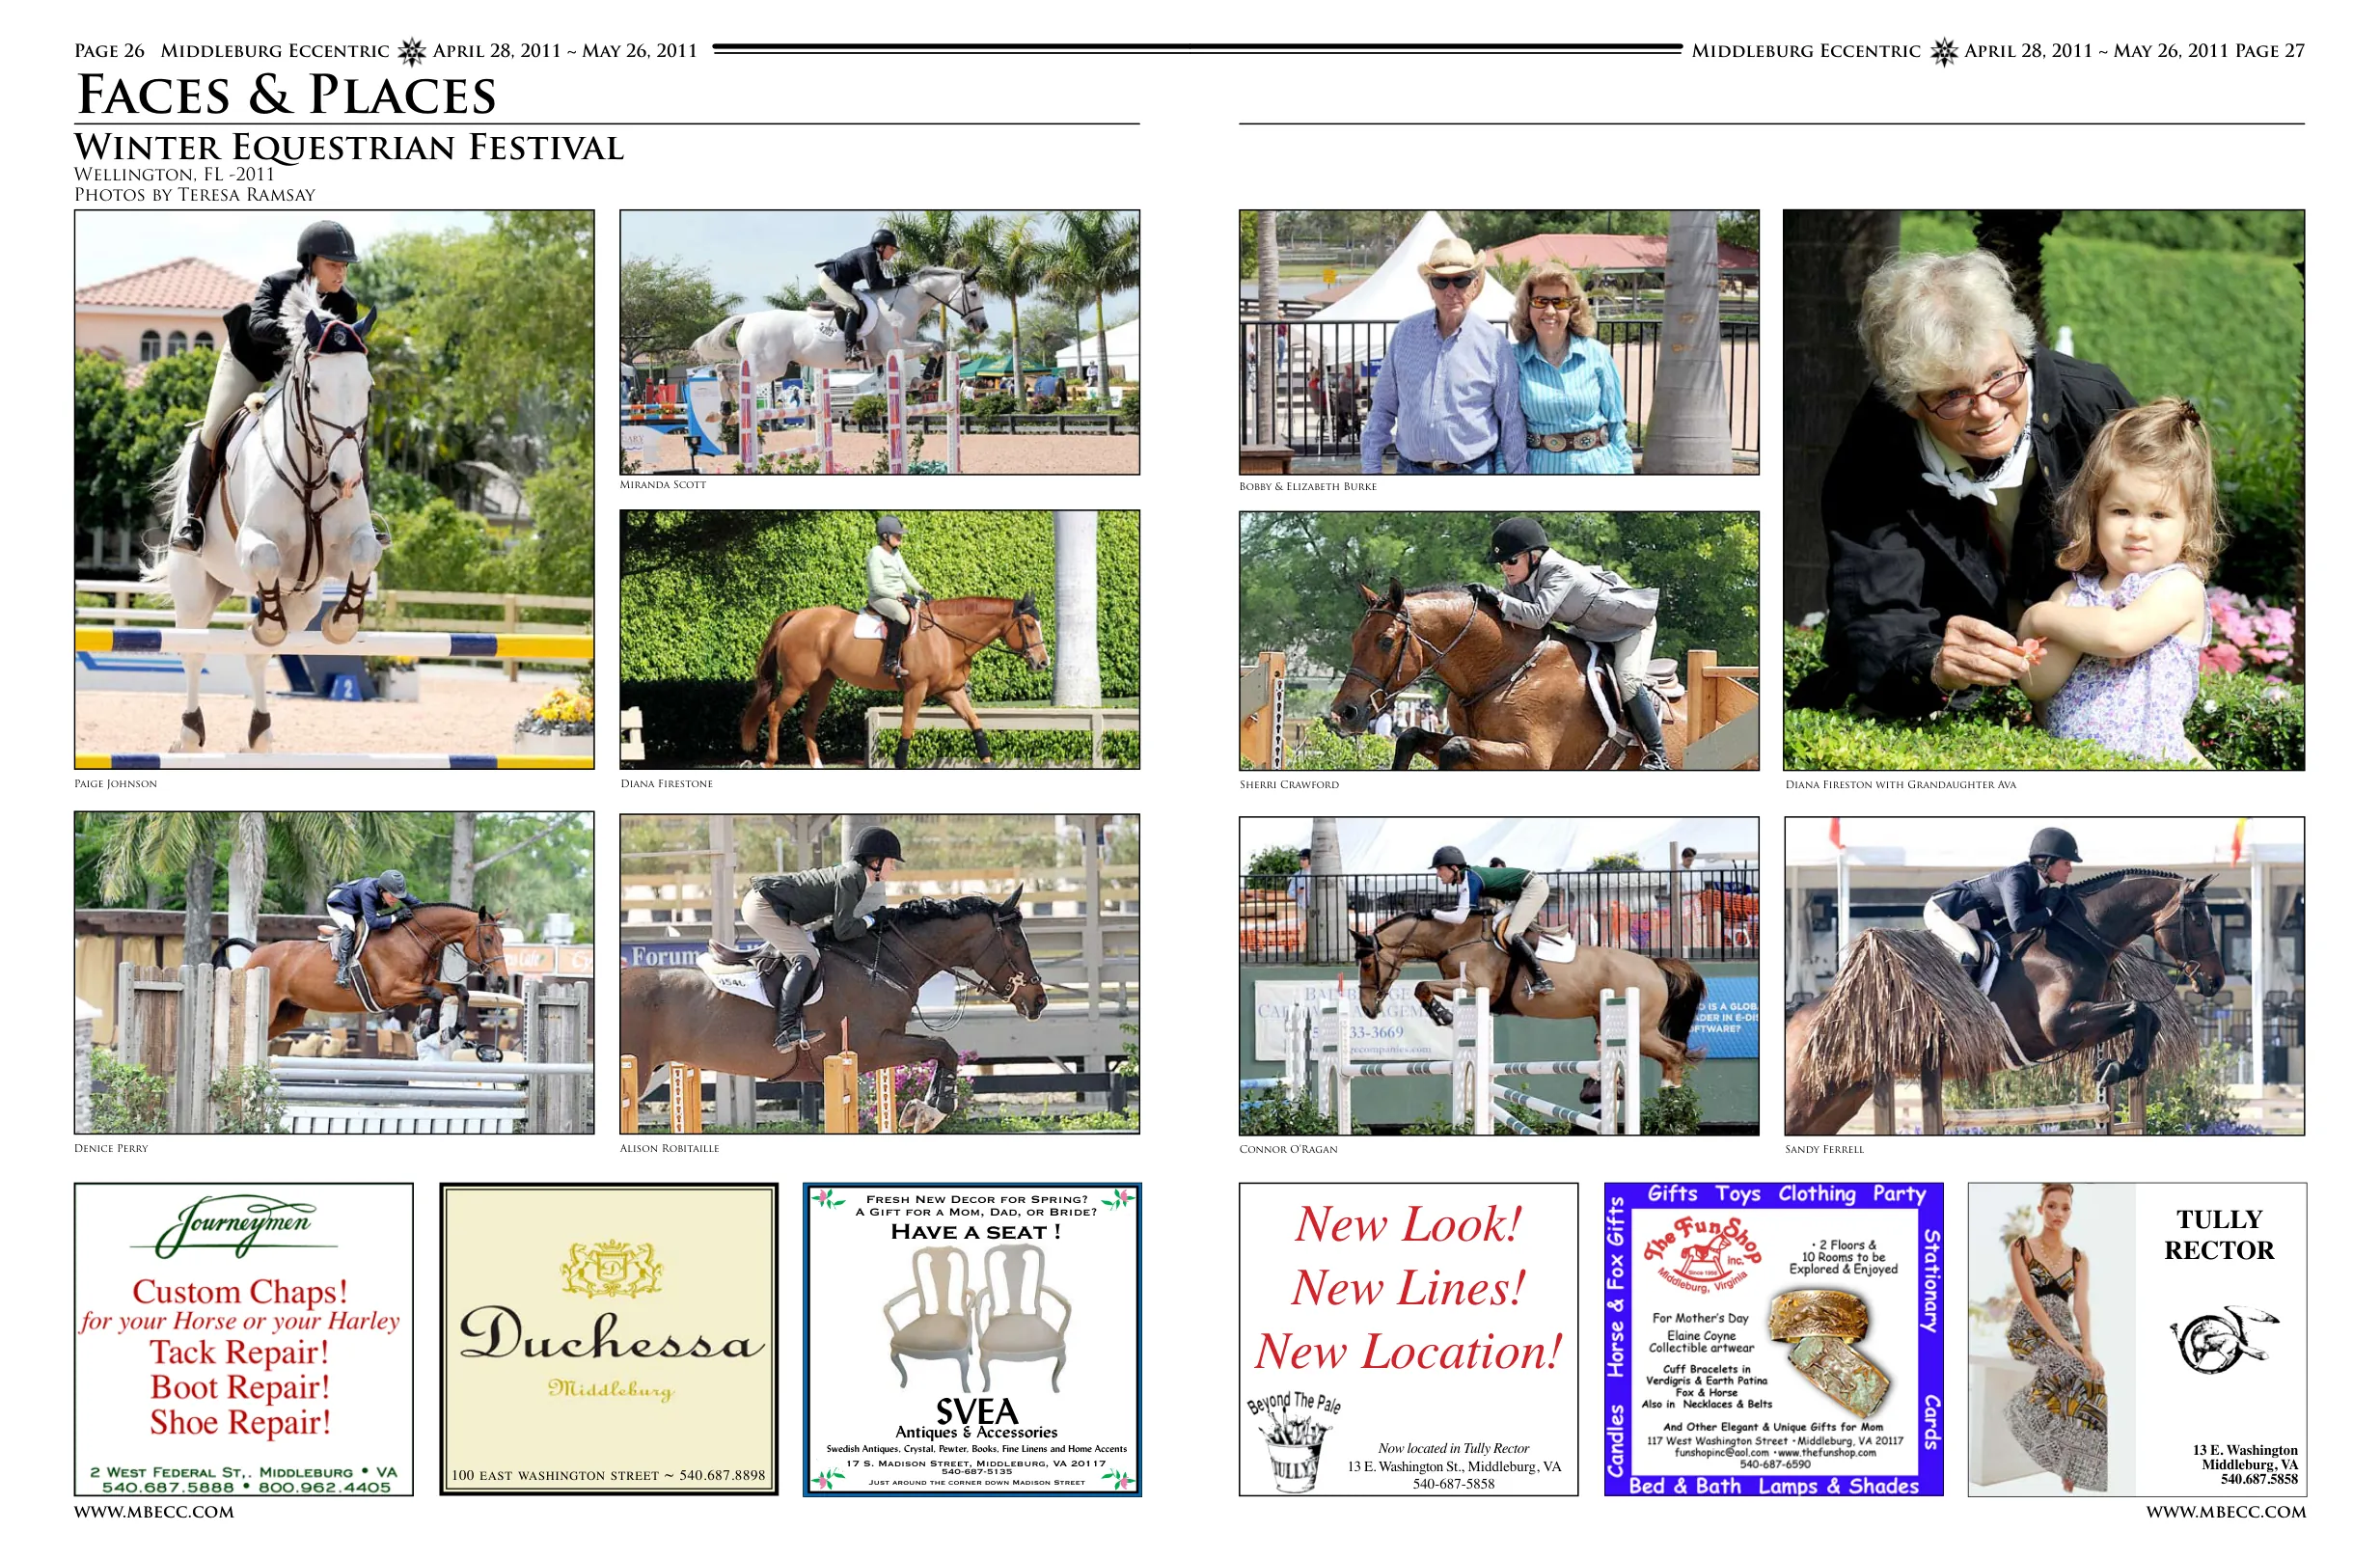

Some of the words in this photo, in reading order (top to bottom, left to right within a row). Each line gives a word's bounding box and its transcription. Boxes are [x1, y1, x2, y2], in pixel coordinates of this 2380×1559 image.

[626, 43, 650, 59] 26,
[657, 43, 696, 58] 2011
[632, 946, 698, 966] Forum
[1730, 1002, 1759, 1011] GLOB
[1649, 1185, 1697, 1202] Gifts
[1715, 1185, 1761, 1206] Toys
[1779, 1185, 1856, 1206] Clothing
[1874, 1185, 1927, 1206] Party
[154, 1193, 317, 1260] Journeymen
[1295, 1206, 1387, 1242] New
[1401, 1205, 1522, 1242] Look!
[1606, 1196, 1625, 1246] Gifts
[2176, 1210, 2263, 1229] TULLY
[2165, 1241, 2275, 1260] RECTOR
[1606, 1253, 1625, 1291] Fox
[1657, 1267, 1710, 1295] Middleburg,
[1713, 1271, 1748, 1291] Virginia
[1920, 1228, 1942, 1333] Stationary
[133, 1279, 241, 1304] Custom
[250, 1279, 346, 1310] Chaps!
[1291, 1270, 1383, 1305] New
[1396, 1269, 1526, 1305] Lines!
[1654, 1313, 1672, 1323] For
[1676, 1313, 1724, 1323] Mother's
[1729, 1313, 1749, 1326] Day
[460, 1305, 765, 1358] Duchessa
[1668, 1330, 1701, 1341] Elaine
[1704, 1330, 1736, 1342] Coyne
[150, 1339, 216, 1364] Tack
[226, 1339, 327, 1372] Repair!
[1254, 1333, 1347, 1369] New
[1360, 1332, 1563, 1369] Location!
[1606, 1321, 1625, 1379] Horse
[1649, 1342, 1708, 1353] Collectible
[1710, 1342, 1755, 1353] artwear
[150, 1375, 218, 1399] Boot
[228, 1374, 328, 1406] Repair!
[548, 1379, 674, 1403] Middleburg
[937, 1398, 1019, 1425] SVEA
[1247, 1391, 1291, 1415] Beyond
[1295, 1391, 1314, 1409] The
[1317, 1394, 1341, 1415] Pale
[150, 1409, 218, 1435] Shoe
[229, 1409, 329, 1441] Repair!
[1924, 1394, 1942, 1451] Cards
[895, 1426, 957, 1441] Antiques
[964, 1426, 971, 1438] &
[976, 1426, 1057, 1438] Accessories
[1606, 1404, 1625, 1478] Candles
[862, 1445, 901, 1454] Antiques,
[904, 1445, 936, 1454] Crystal,
[1379, 1443, 1405, 1453] Now
[1408, 1443, 1447, 1453] located
[1450, 1443, 1460, 1453] in
[1464, 1442, 1491, 1456] Tully
[1493, 1443, 1530, 1453] Rector
[1675, 1447, 1769, 1459] funshopinc@aol.com
[1778, 1447, 1876, 1459] www.thefunshop.com
[2194, 1444, 2206, 1455] 13
[2210, 1445, 2223, 1455] E.
[2227, 1444, 2298, 1458] Washington
[1740, 1460, 1811, 1468] 540-687-6590
[2202, 1459, 2278, 1472] Middleburg,
[2282, 1460, 2299, 1469] VA
[103, 1483, 233, 1492] 540.687.5888
[260, 1483, 391, 1492] 800.962.4405
[1413, 1478, 1494, 1489] 540-687-5858
[1630, 1477, 1664, 1494] Bed
[1674, 1477, 1686, 1495] &
[1697, 1477, 1740, 1494] Bath
[1760, 1478, 1818, 1495] Lamps
[1827, 1477, 1840, 1493] &
[1849, 1477, 1919, 1494] Shades
[2221, 1473, 2298, 1484] 540.687.5858
